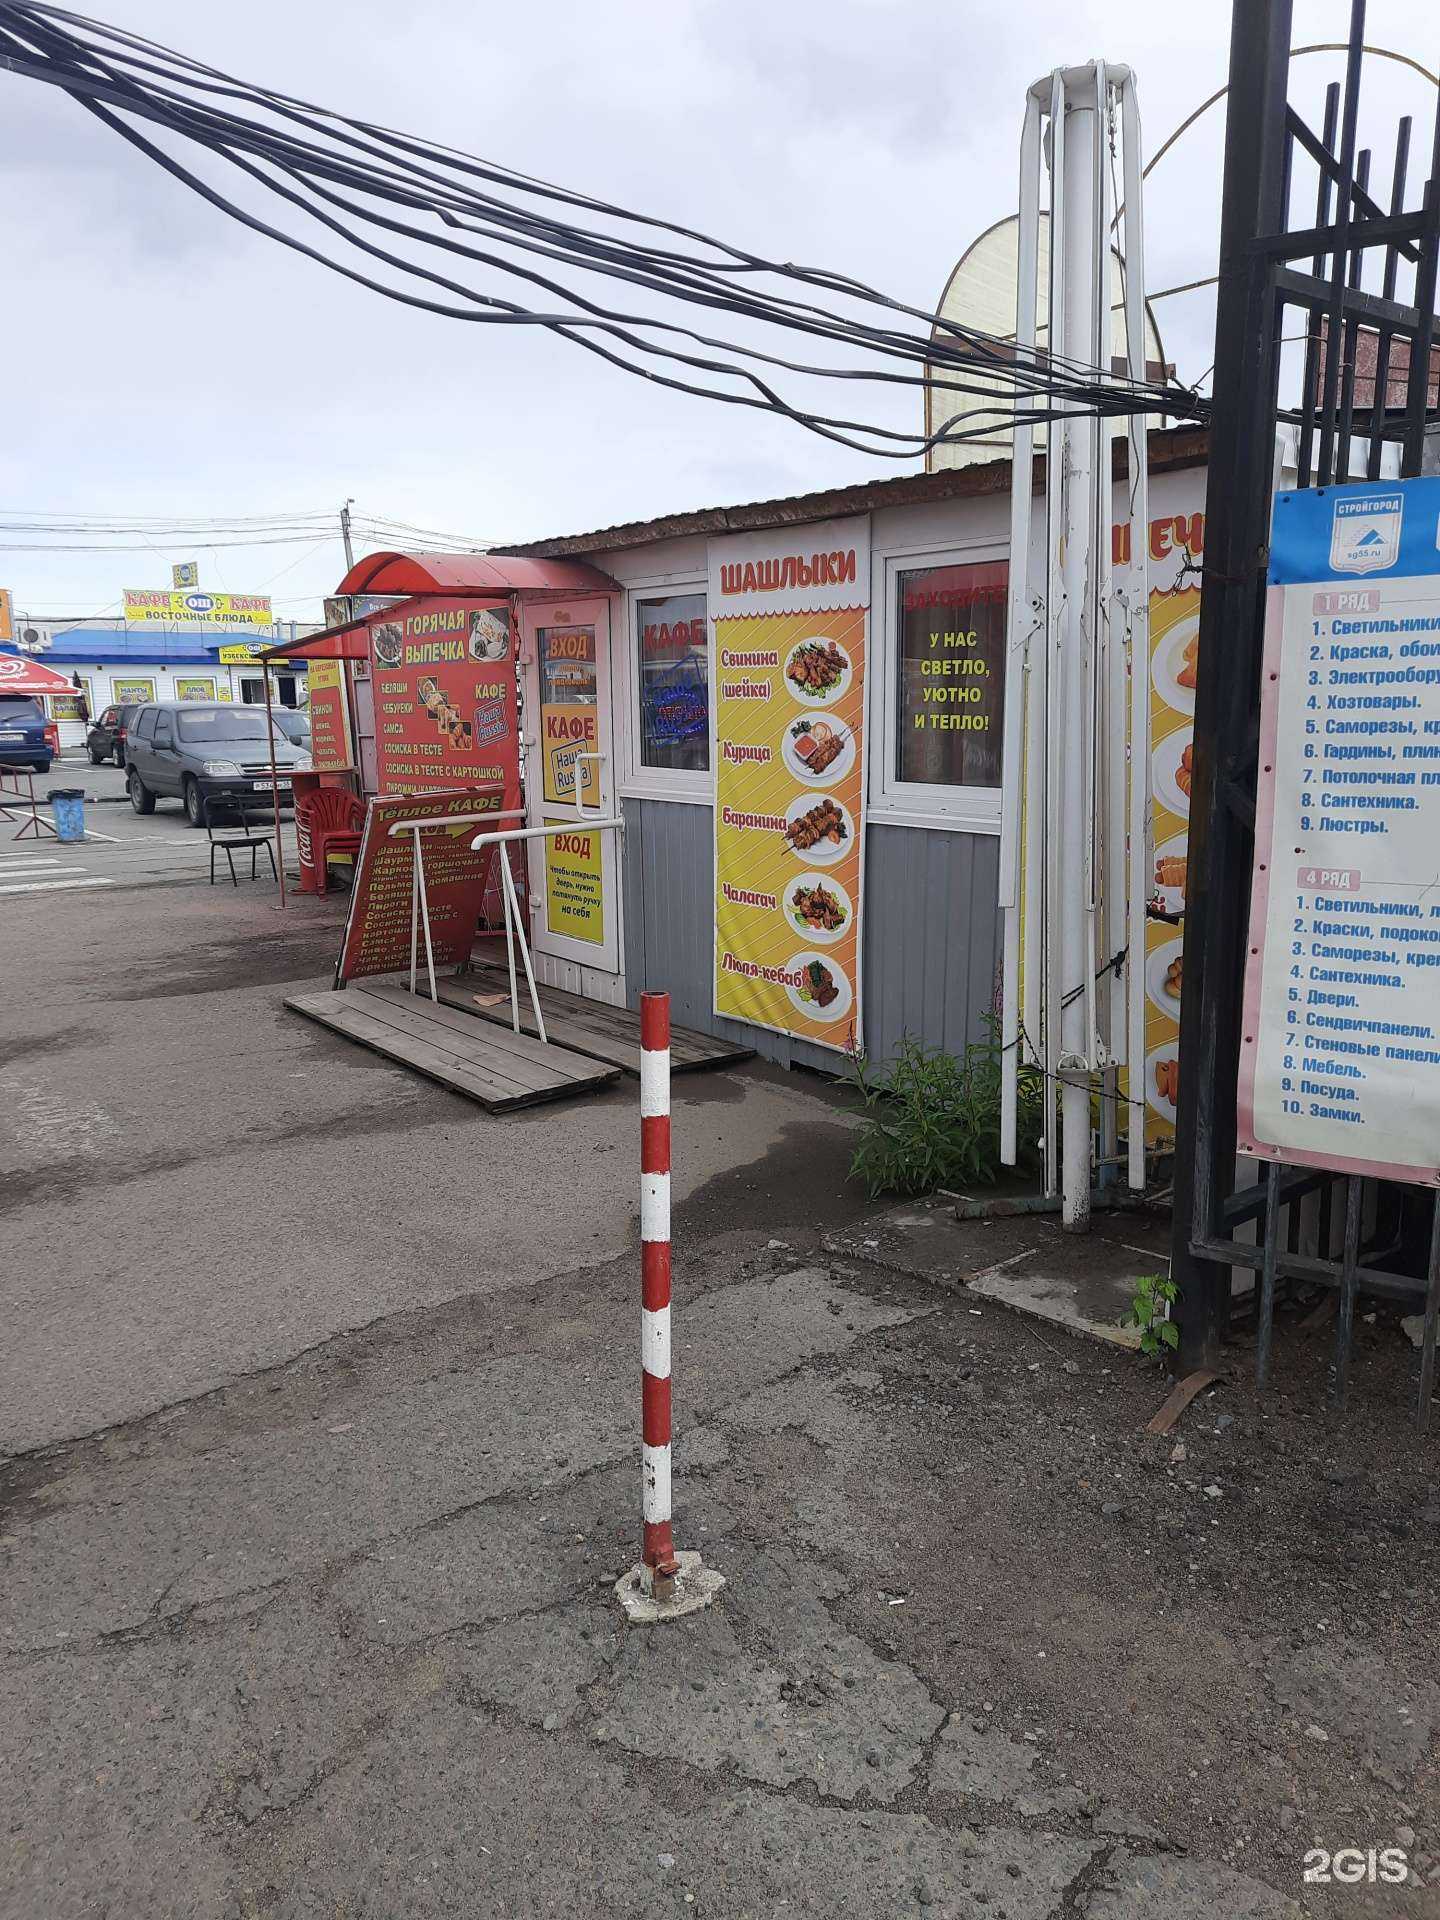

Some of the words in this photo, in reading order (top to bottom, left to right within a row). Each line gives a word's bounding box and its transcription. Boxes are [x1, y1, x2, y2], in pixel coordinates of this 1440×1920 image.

[1338, 500, 1399, 514] СТРОЙГОРОД
[1347, 550, 1381, 560] sg55.ru
[720, 549, 856, 595] ШАШЛЫКИ
[127, 592, 170, 607] КАФЕ
[229, 597, 271, 612] КАФЕ
[1337, 593, 1369, 612] РЯД
[145, 610, 212, 621] ВОСТОЧНЫЕ
[214, 613, 253, 624] БЛЮДА
[406, 610, 465, 636] ГОРЯЧАЯ
[644, 619, 705, 649] КАФЕ
[1312, 621, 1326, 635] 1.
[550, 636, 588, 659] ВХОД
[929, 632, 939, 648] У
[944, 631, 977, 648] НАС
[405, 640, 466, 664] ВЫПЕЧКА
[721, 650, 778, 667] Свинина
[1310, 645, 1324, 660] 2.
[1330, 645, 1393, 662] Краска,
[921, 659, 990, 679] СВЕТЛО,
[1308, 670, 1322, 685] 3.
[381, 682, 408, 694] БЕЛЯШИ
[475, 683, 506, 699] КАФЕ
[721, 679, 771, 702] (шейка)
[923, 687, 981, 703] УЮТНО
[1306, 695, 1321, 709] 4.
[1326, 695, 1421, 711] Хозтовары.
[383, 723, 404, 734] САМСА
[547, 716, 595, 740] КАФЕ
[914, 714, 924, 729] И
[930, 714, 989, 731] ТЕПЛО!
[1305, 719, 1320, 734] 5.
[1325, 719, 1418, 735] Саморезы,
[384, 743, 412, 754] СОСИСКА
[413, 744, 419, 754] В
[419, 744, 443, 756] ТЕСТЕ
[723, 743, 771, 764] Курица
[1304, 744, 1318, 758] 6.
[1323, 743, 1396, 760] Гардины,
[385, 763, 414, 775] СОСИСКА
[414, 764, 420, 775] В
[420, 764, 444, 777] ТЕСТЕ
[445, 765, 451, 776] С
[453, 764, 504, 779] КАРТОШКОЙ
[557, 767, 588, 787] Rusa
[1303, 769, 1317, 783] 7.
[1322, 769, 1416, 785] Потолочная
[378, 803, 443, 822] Тёплое
[447, 796, 501, 813] КАФЕ
[1301, 792, 1315, 807] 8.
[1321, 793, 1420, 809] Сантехника.
[722, 807, 787, 831] Баранина
[1300, 816, 1314, 831] 9.
[1319, 817, 1389, 834] Люстры.
[377, 844, 433, 856] Шашлки
[554, 834, 591, 860] ВХОД
[374, 856, 415, 867] Шаурм
[550, 865, 571, 876] Чтобы
[570, 870, 601, 881] открыть
[1306, 872, 1316, 884] 4
[1321, 871, 1351, 889] РЯД
[369, 881, 414, 892] Пельме
[556, 878, 575, 889] дверь,
[575, 883, 595, 893] нужно
[552, 890, 583, 902] потянуть
[583, 896, 601, 907] ручку
[722, 883, 776, 909] Чалагач
[368, 901, 408, 910] Пироги
[561, 905, 571, 914] на
[572, 907, 591, 919] себя
[1296, 896, 1309, 910] 1.
[1315, 896, 1424, 919] Светильники,
[364, 918, 411, 930] Сосиска
[1293, 919, 1307, 933] 2.
[1312, 920, 1374, 939] Краски,
[362, 937, 396, 947] Самса
[1292, 941, 1306, 956] 3.
[1311, 942, 1401, 965] Саморезы,
[721, 953, 804, 988] Люля-кебаб
[1290, 965, 1304, 979] 4.
[1309, 966, 1406, 988] Сантехника.
[1288, 988, 1302, 1002] 5.
[1307, 989, 1359, 1008] Двери.
[1287, 1010, 1300, 1024] 6.
[1306, 1012, 1435, 1039] Сендвичпанели.
[1285, 1032, 1299, 1047] 7.
[1304, 1034, 1381, 1057] Стеновые
[1283, 1055, 1297, 1069] 8.
[1302, 1057, 1367, 1079] Мебель.
[1281, 1077, 1295, 1092] 9.
[1300, 1080, 1359, 1101] Посуда.
[1281, 1099, 1304, 1114] 10.
[1309, 1103, 1365, 1124] Замки.
